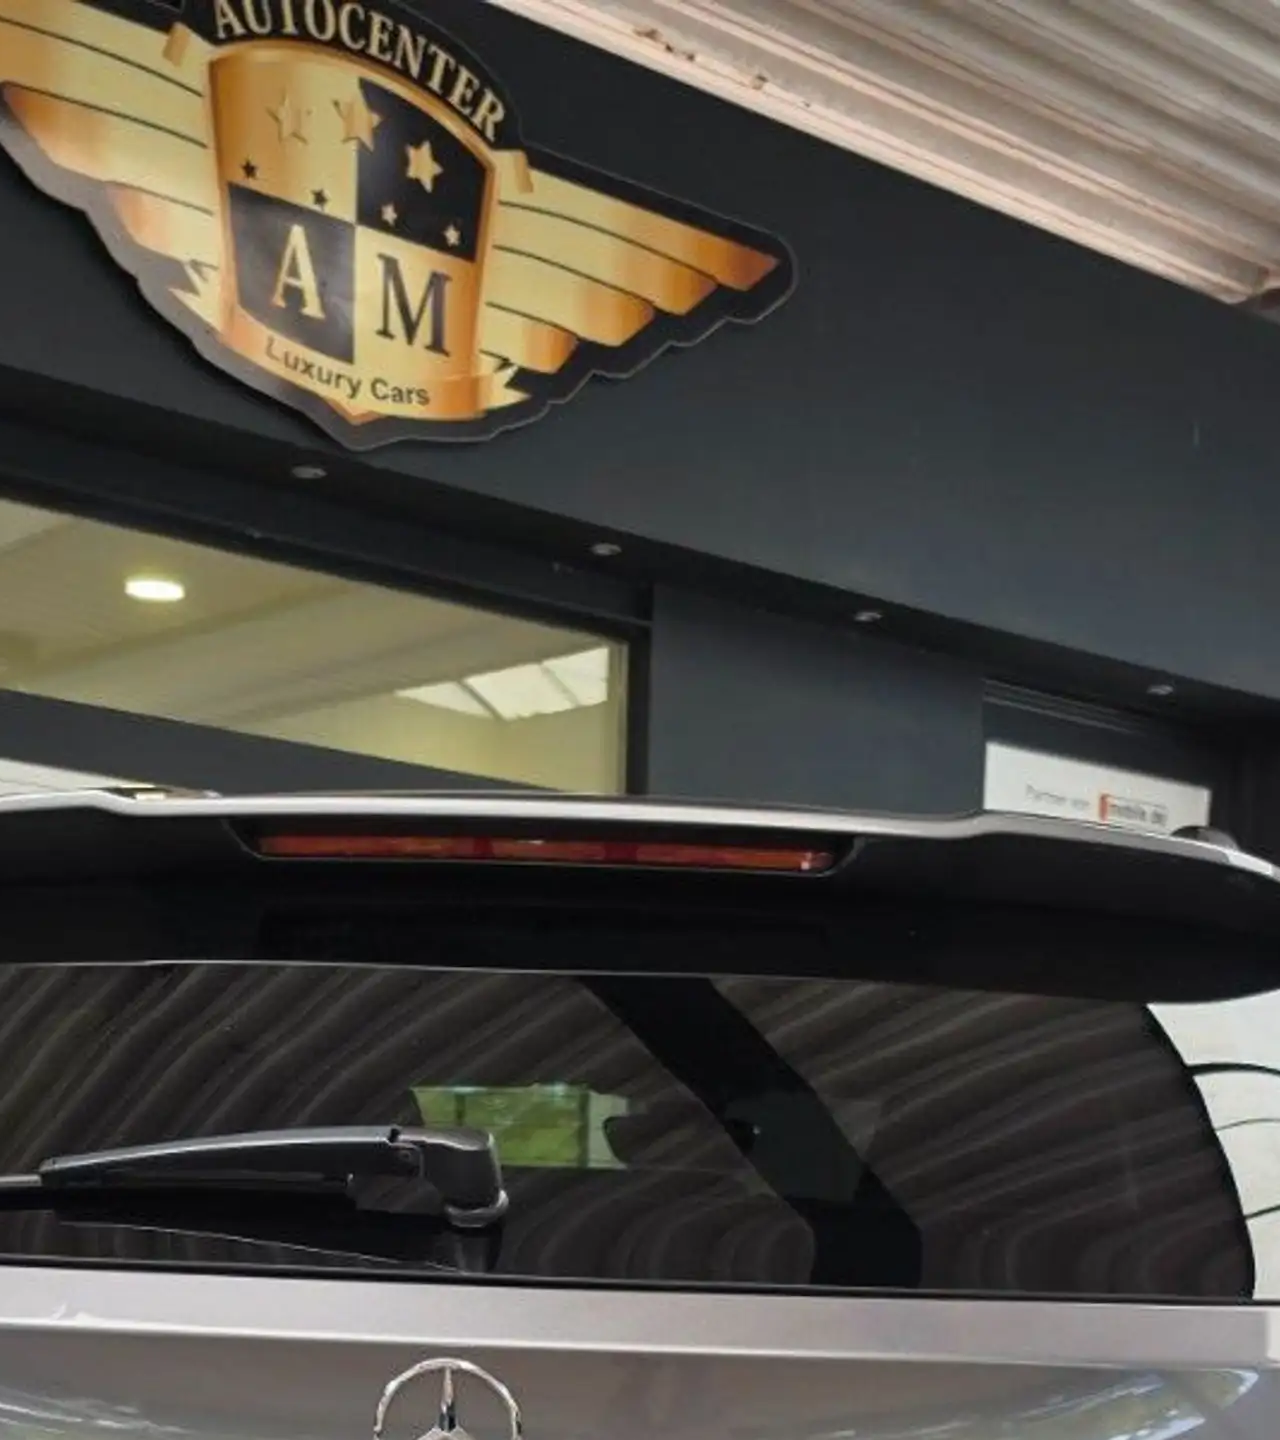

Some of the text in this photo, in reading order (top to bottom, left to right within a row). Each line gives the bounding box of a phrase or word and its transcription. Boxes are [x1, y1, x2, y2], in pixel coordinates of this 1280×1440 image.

[215, 0, 506, 142] AUTOCENTER
[272, 224, 452, 358] A M
[265, 335, 431, 406] Luxury Cars
